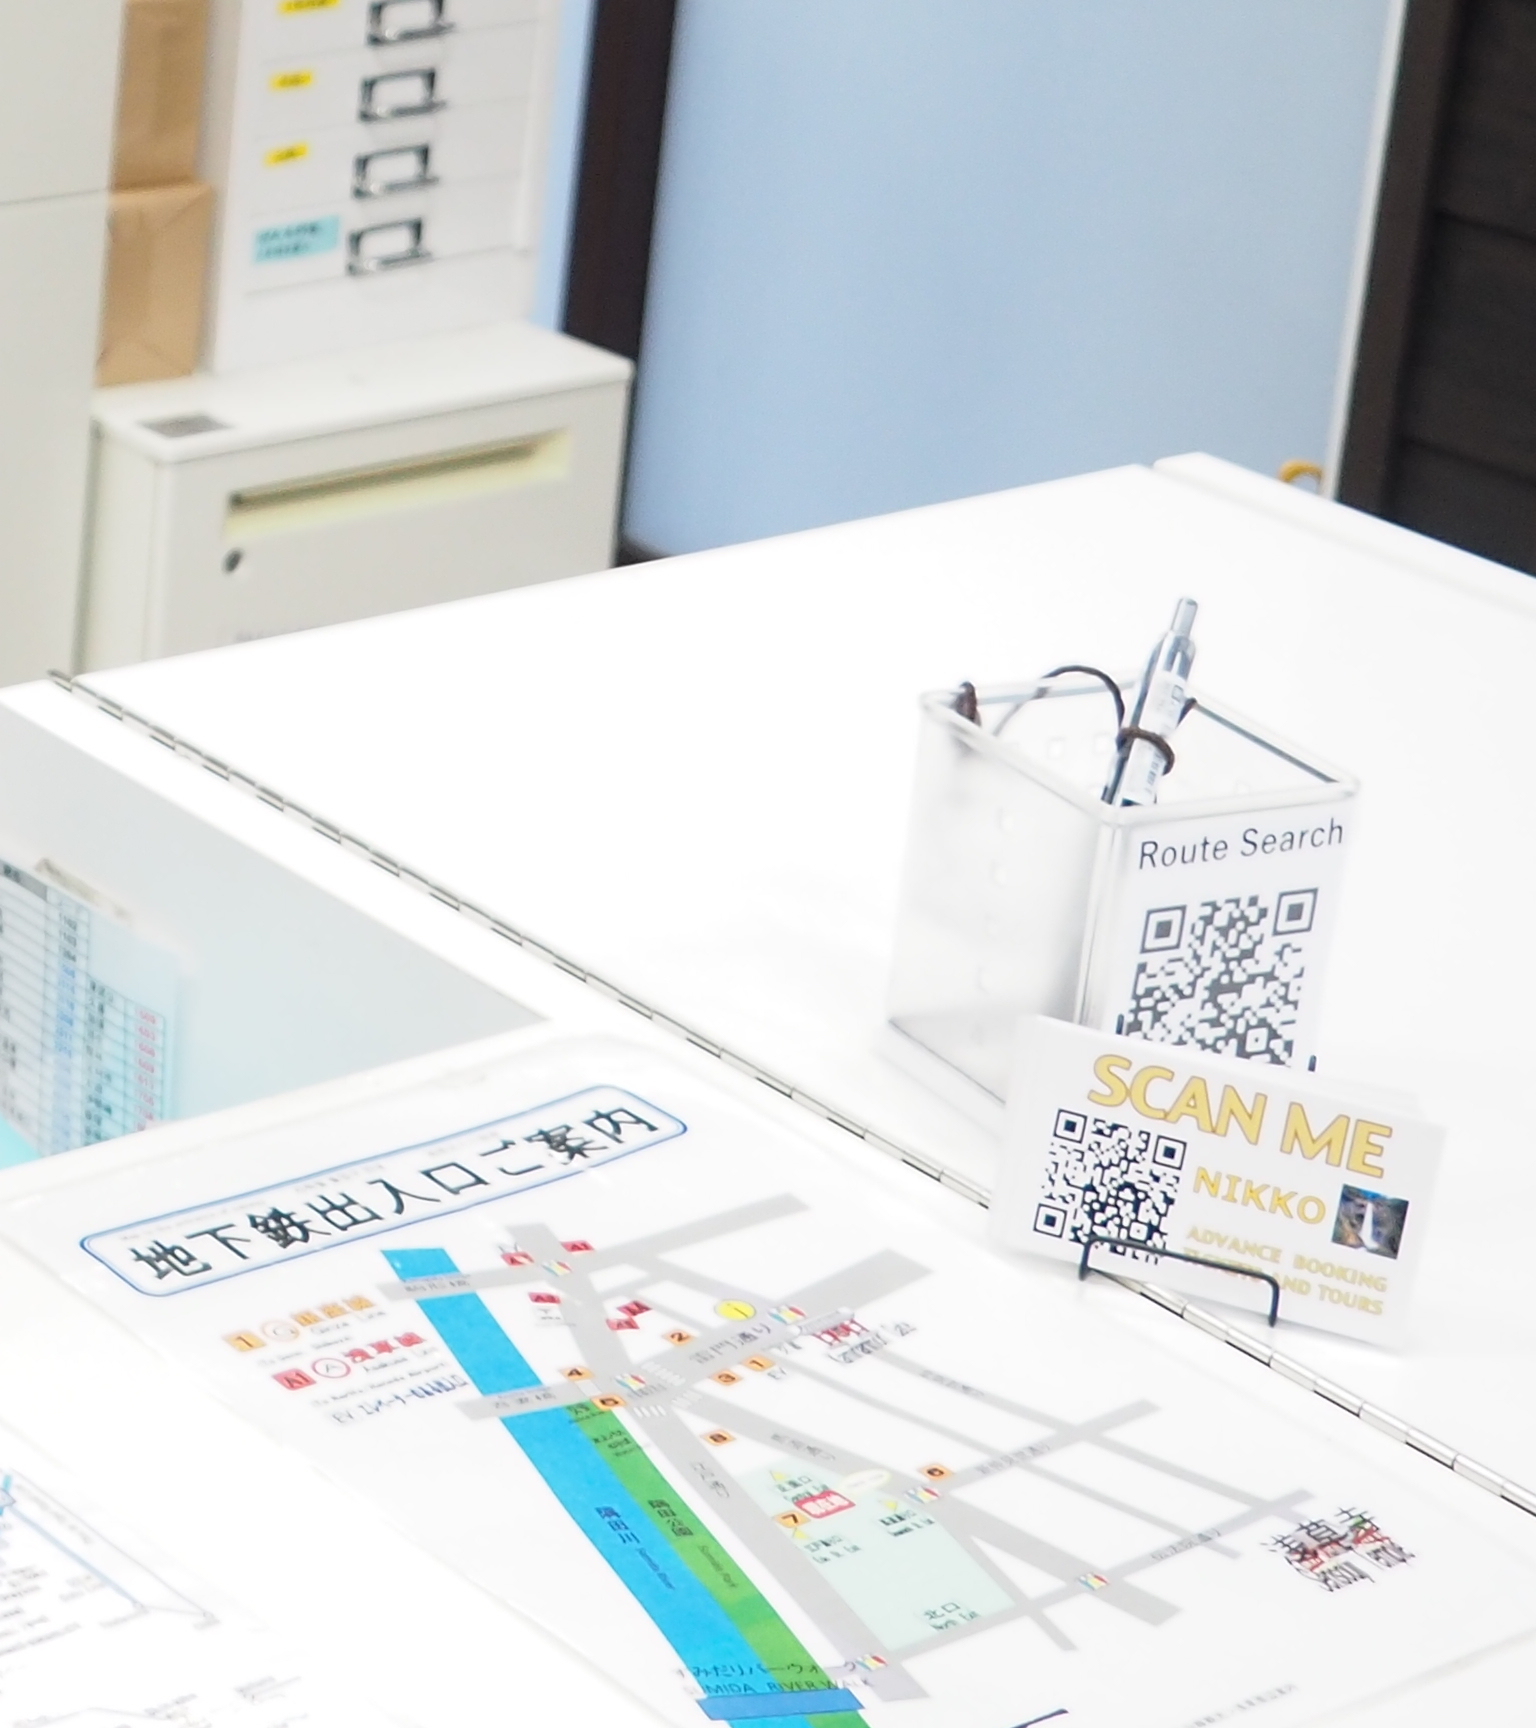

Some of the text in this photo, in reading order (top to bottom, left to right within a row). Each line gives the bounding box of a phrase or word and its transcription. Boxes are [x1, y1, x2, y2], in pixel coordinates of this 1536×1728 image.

[1139, 817, 1344, 870] Route Search
[1087, 1054, 1393, 1179] SCAN ME
[131, 1106, 662, 1282] 地下鉄出入口ご案内
[1193, 1167, 1327, 1225] NIKKO
[1188, 1225, 1388, 1294] ADVANCE BOOKING
[1278, 1272, 1385, 1316] AND TOURS
[595, 1505, 641, 1545] 隅田川
[647, 1498, 695, 1538] 隅田公園
[924, 1601, 961, 1621] 北口
[768, 1680, 817, 1693] RIVER
